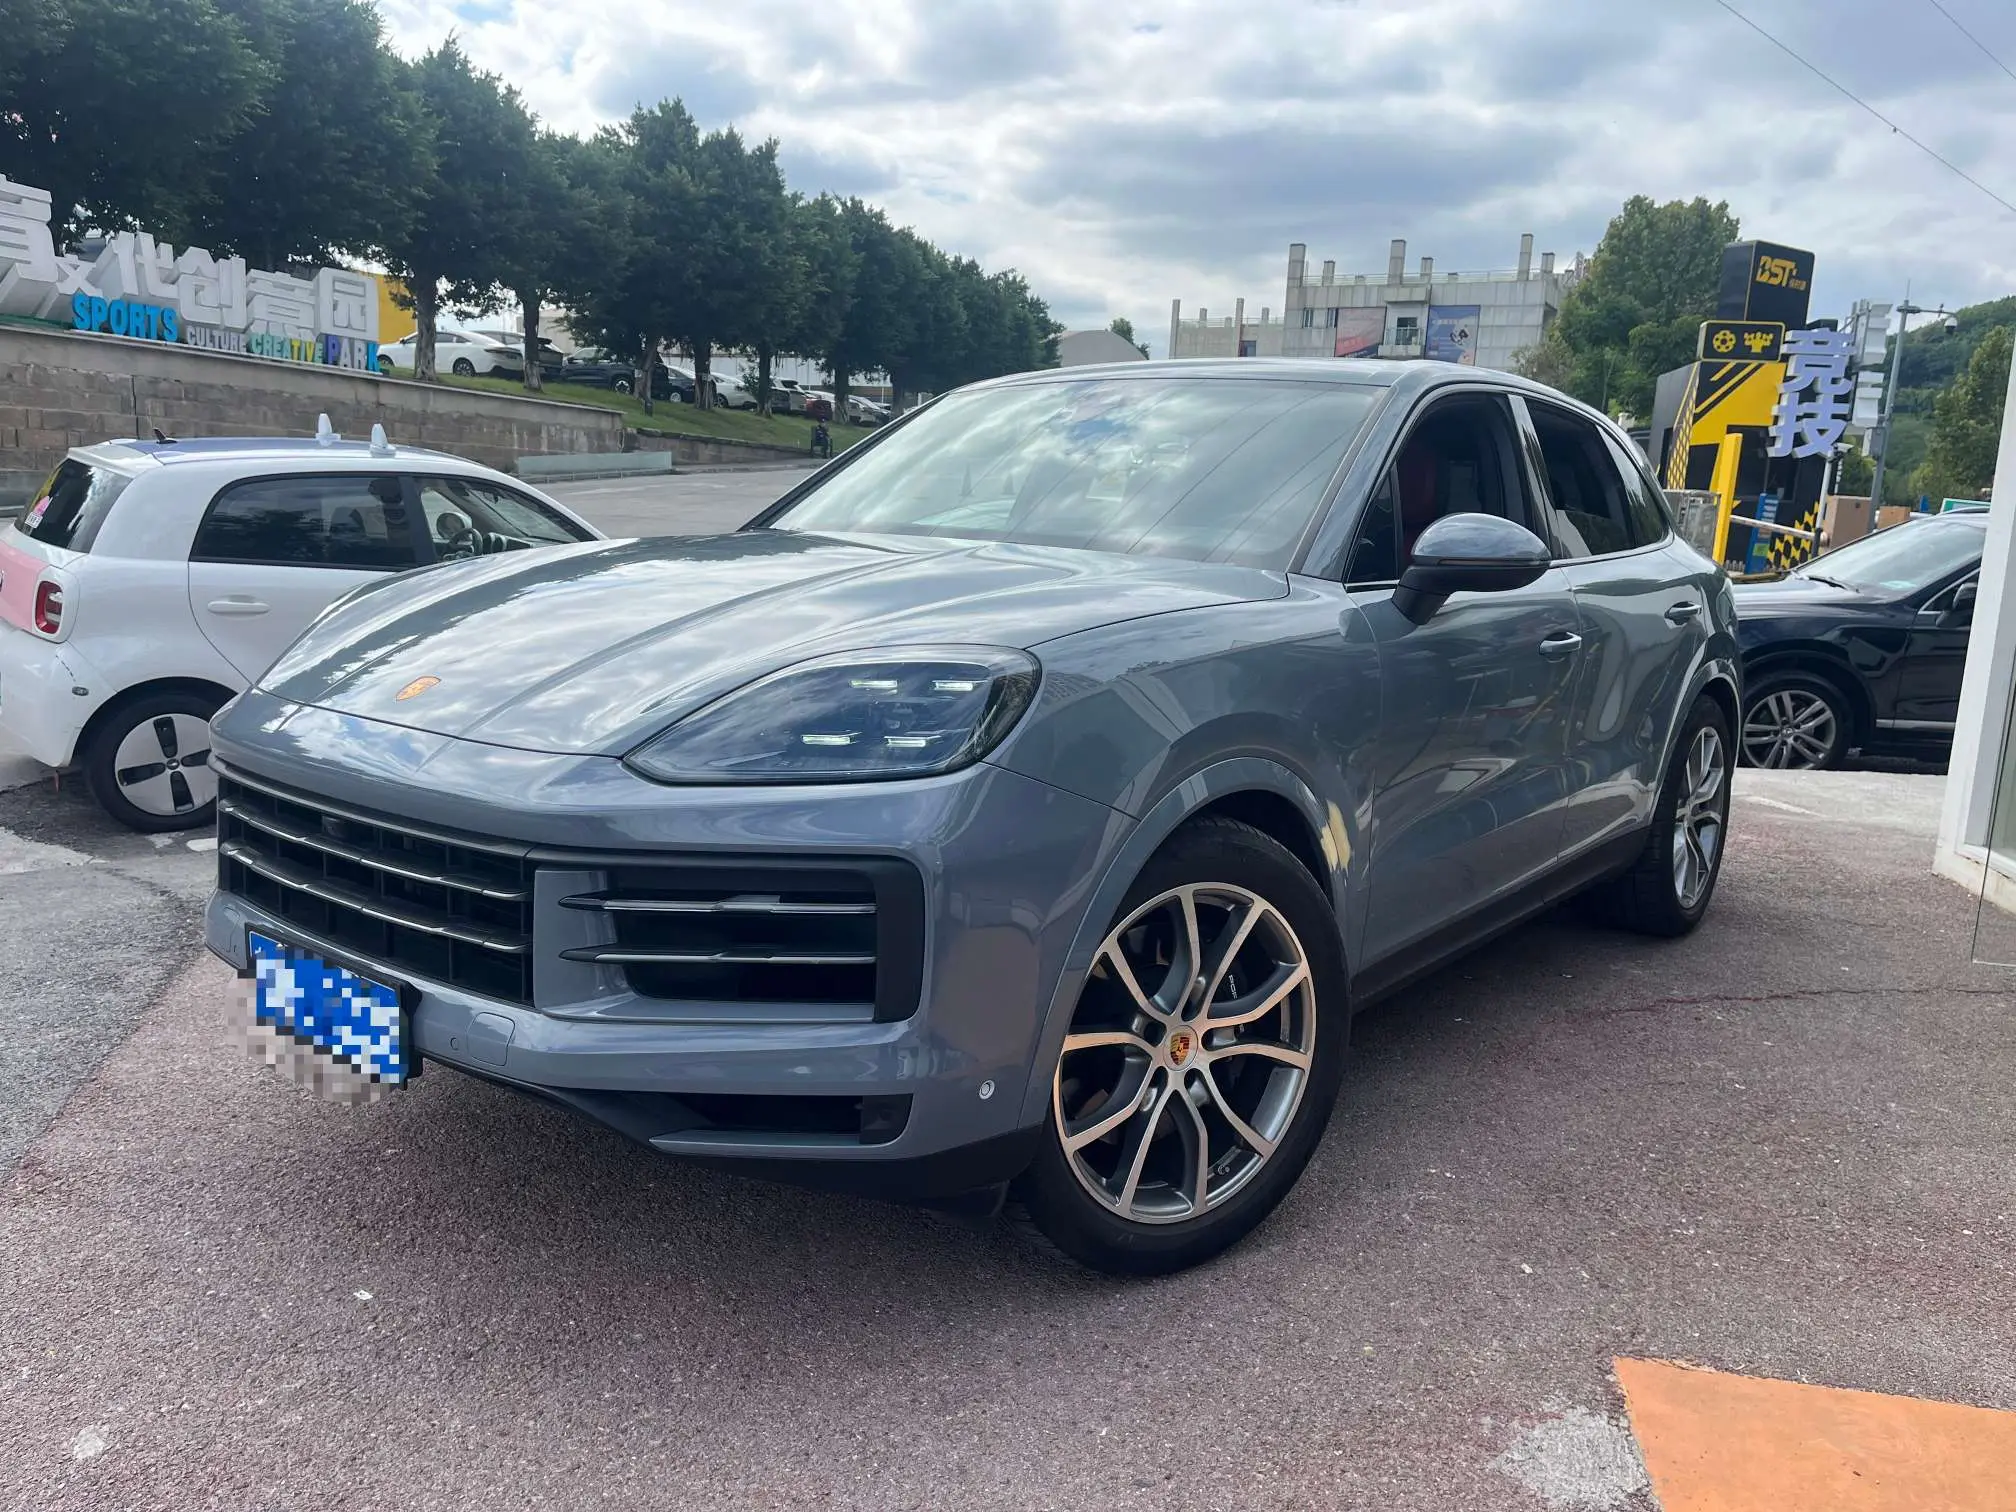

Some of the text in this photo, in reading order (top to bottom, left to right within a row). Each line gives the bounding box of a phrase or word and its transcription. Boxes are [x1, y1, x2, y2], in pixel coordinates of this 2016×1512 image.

[72, 290, 381, 373] SPORTS CULTURE CREATIVE PARK
[1767, 327, 1855, 459] 竞技
